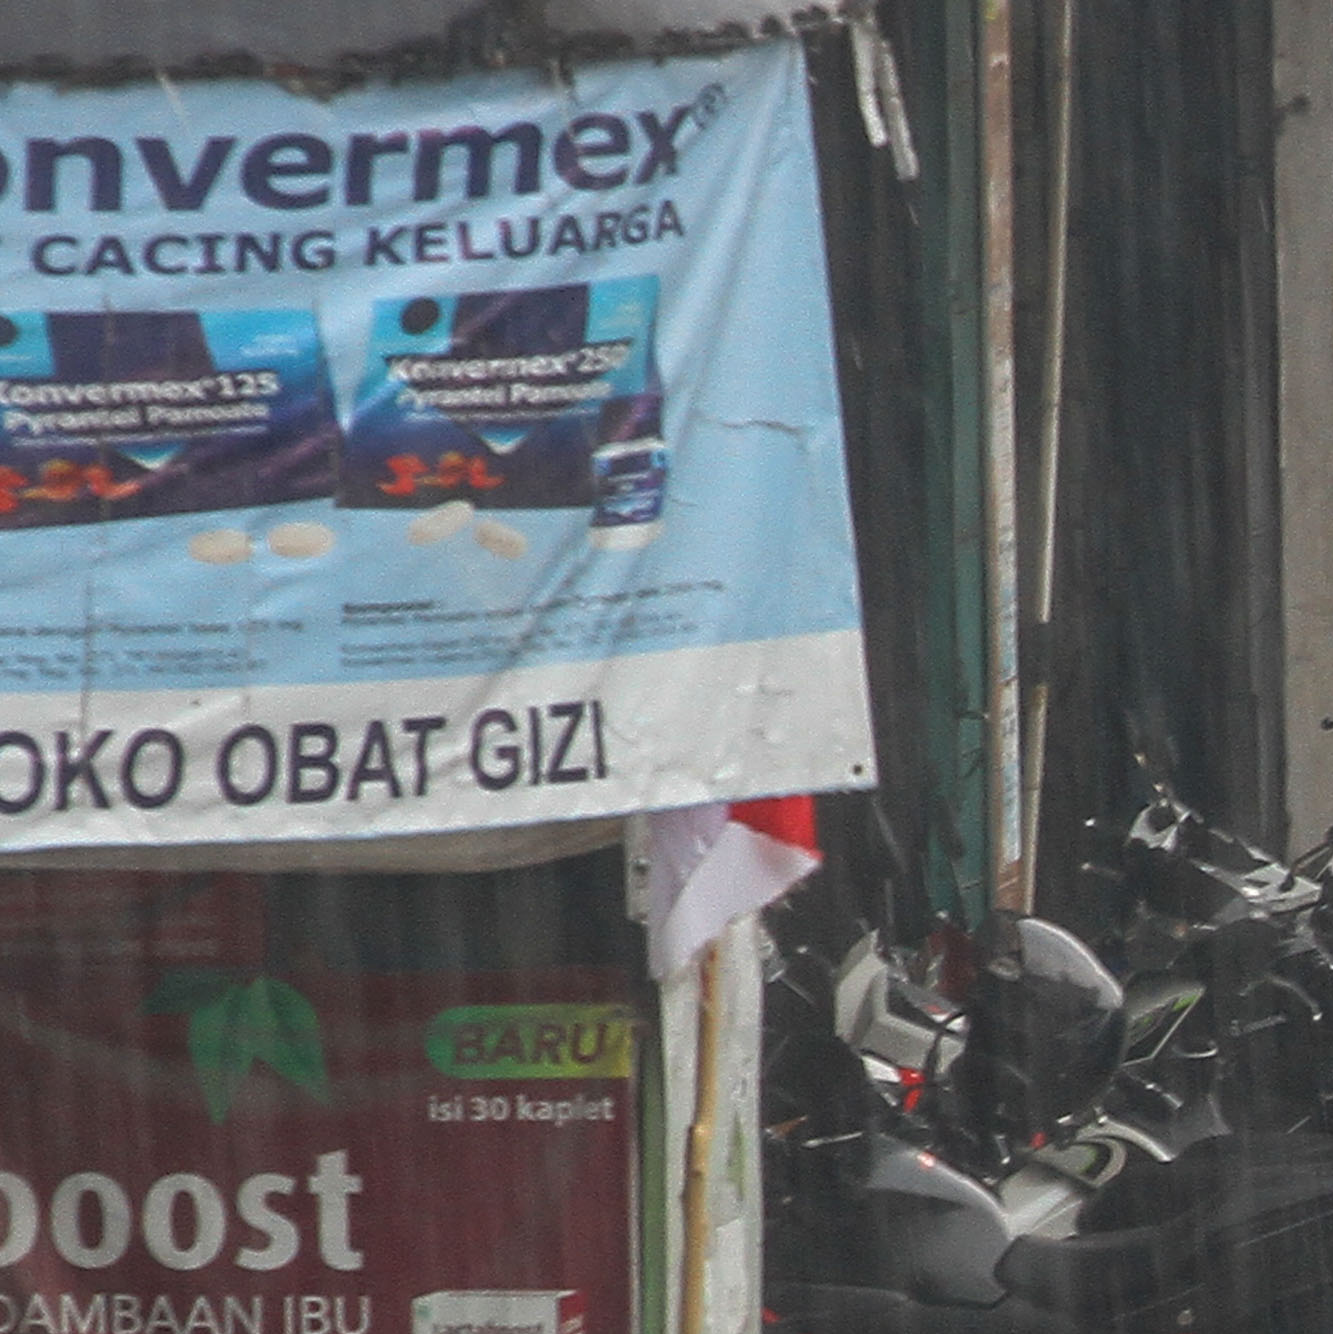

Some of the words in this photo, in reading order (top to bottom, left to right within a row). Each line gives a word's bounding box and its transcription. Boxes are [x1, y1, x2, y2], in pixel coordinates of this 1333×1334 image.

[0, 104, 692, 212] nvermex
[30, 229, 337, 277] CACING
[364, 199, 685, 266] KELUARGA
[215, 717, 447, 807] OBAT
[468, 699, 608, 791] GIZI
[453, 1022, 606, 1064] BARU
[428, 1095, 463, 1122] isi
[469, 1096, 509, 1121] 30
[515, 1094, 615, 1127] kaplet
